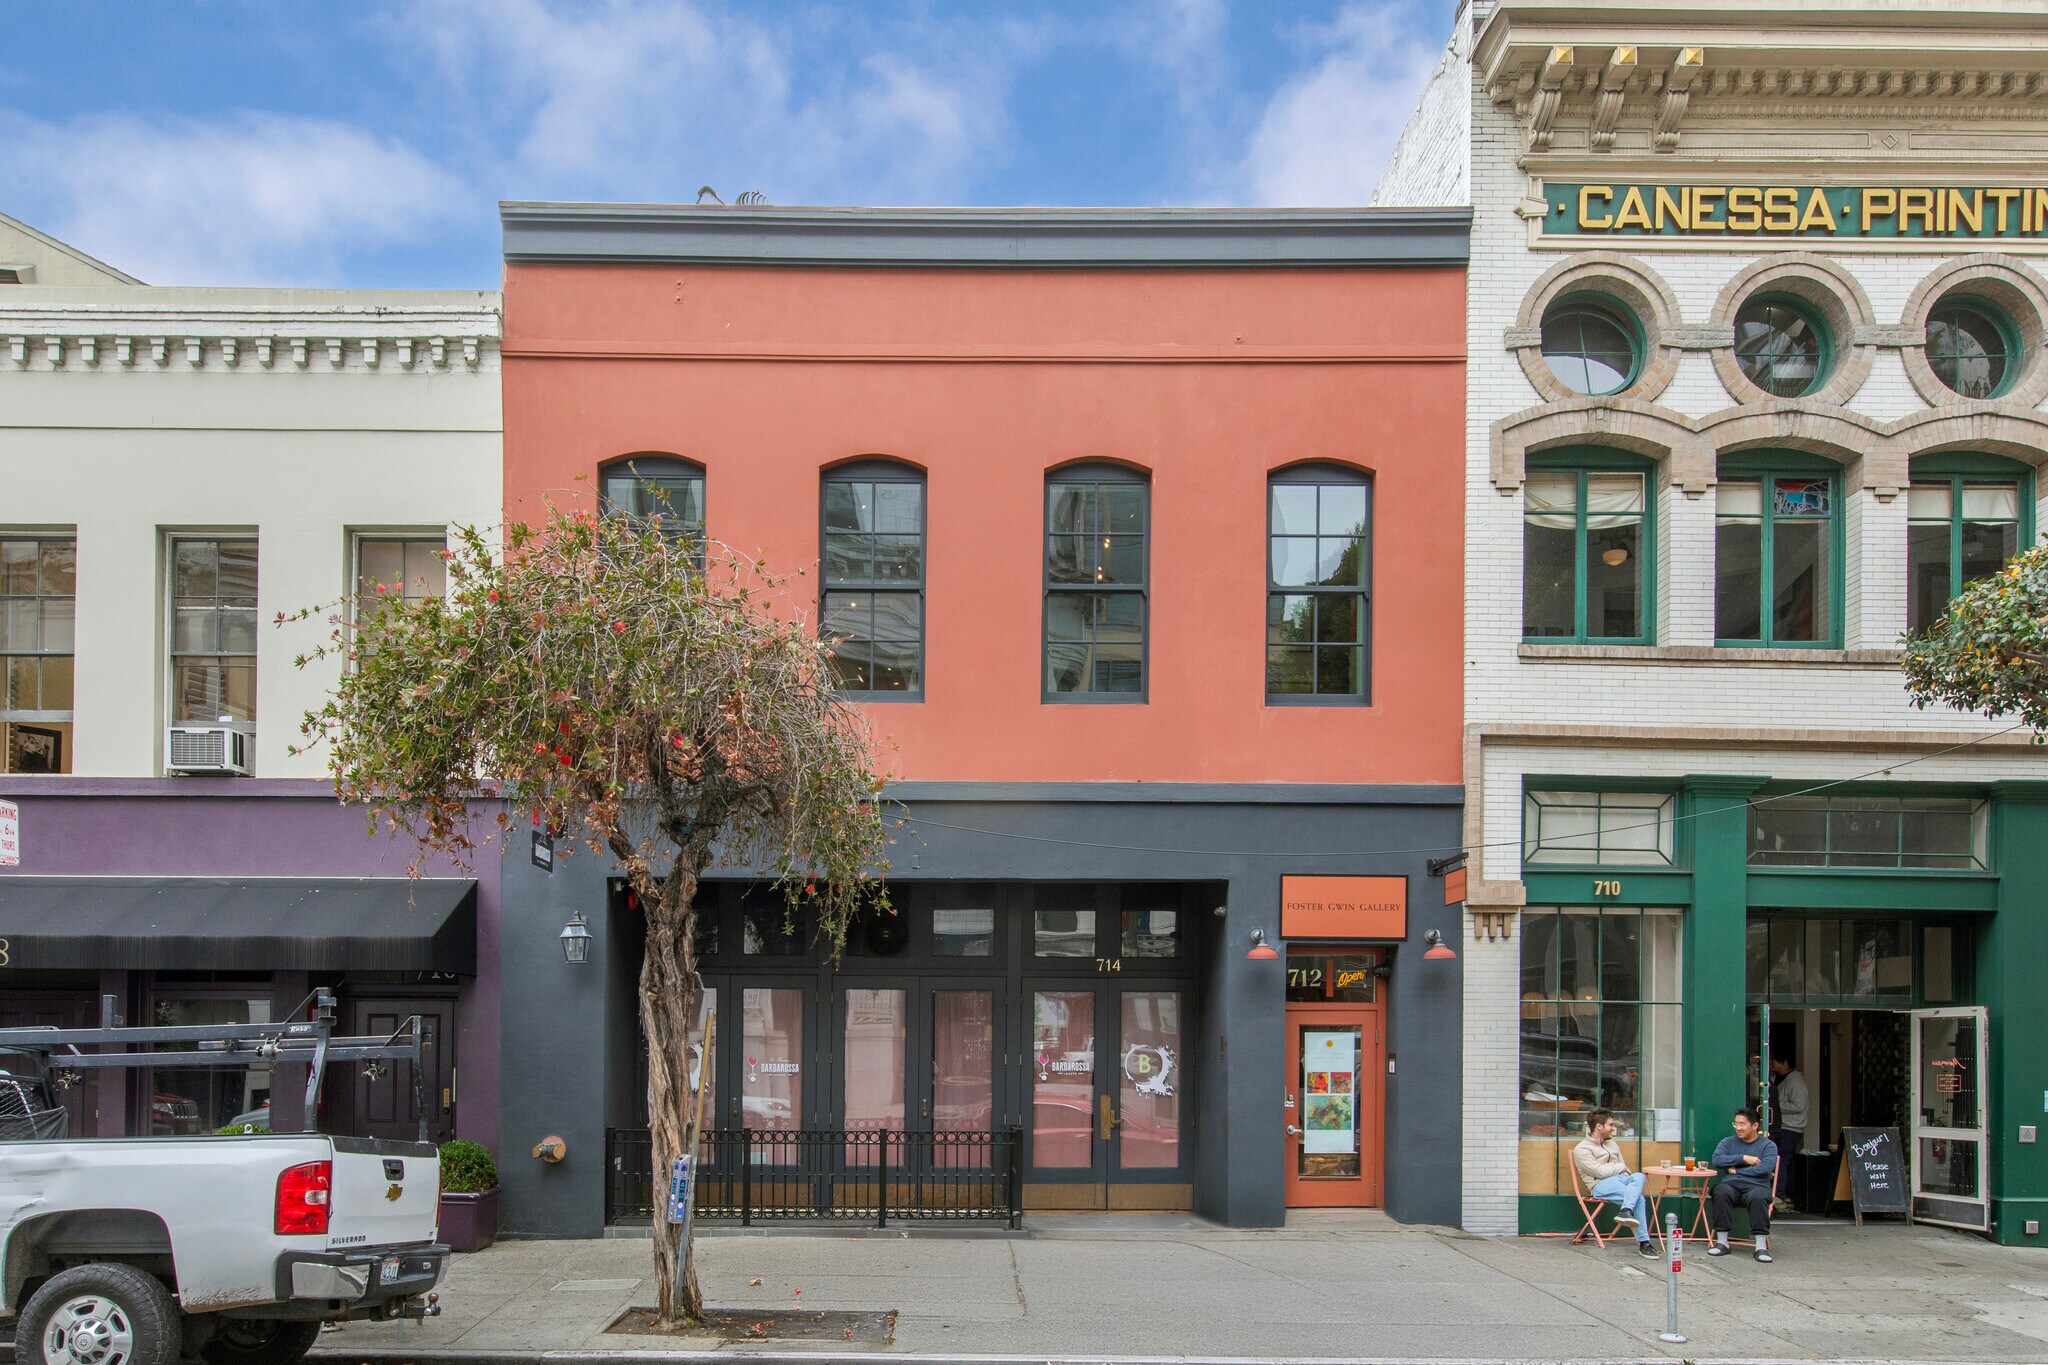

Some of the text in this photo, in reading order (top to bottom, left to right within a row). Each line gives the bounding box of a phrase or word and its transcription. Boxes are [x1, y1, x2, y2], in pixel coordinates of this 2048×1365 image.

[1578, 185, 1837, 231] CANESSA
[1593, 880, 1621, 896] 710
[1286, 902, 1401, 912] FOSTER GWIN GALLERY
[1096, 958, 1121, 972] 714
[1287, 968, 1322, 987] 712
[1337, 970, 1365, 988] Open
[760, 1063, 800, 1073] BARBAROSSA
[1051, 1061, 1090, 1072] BARBAROSSA
[1138, 1053, 1151, 1074] B
[1864, 1162, 1889, 1171] Please
[1870, 1182, 1889, 1190] Here
[331, 1235, 366, 1245] SILVERADO
